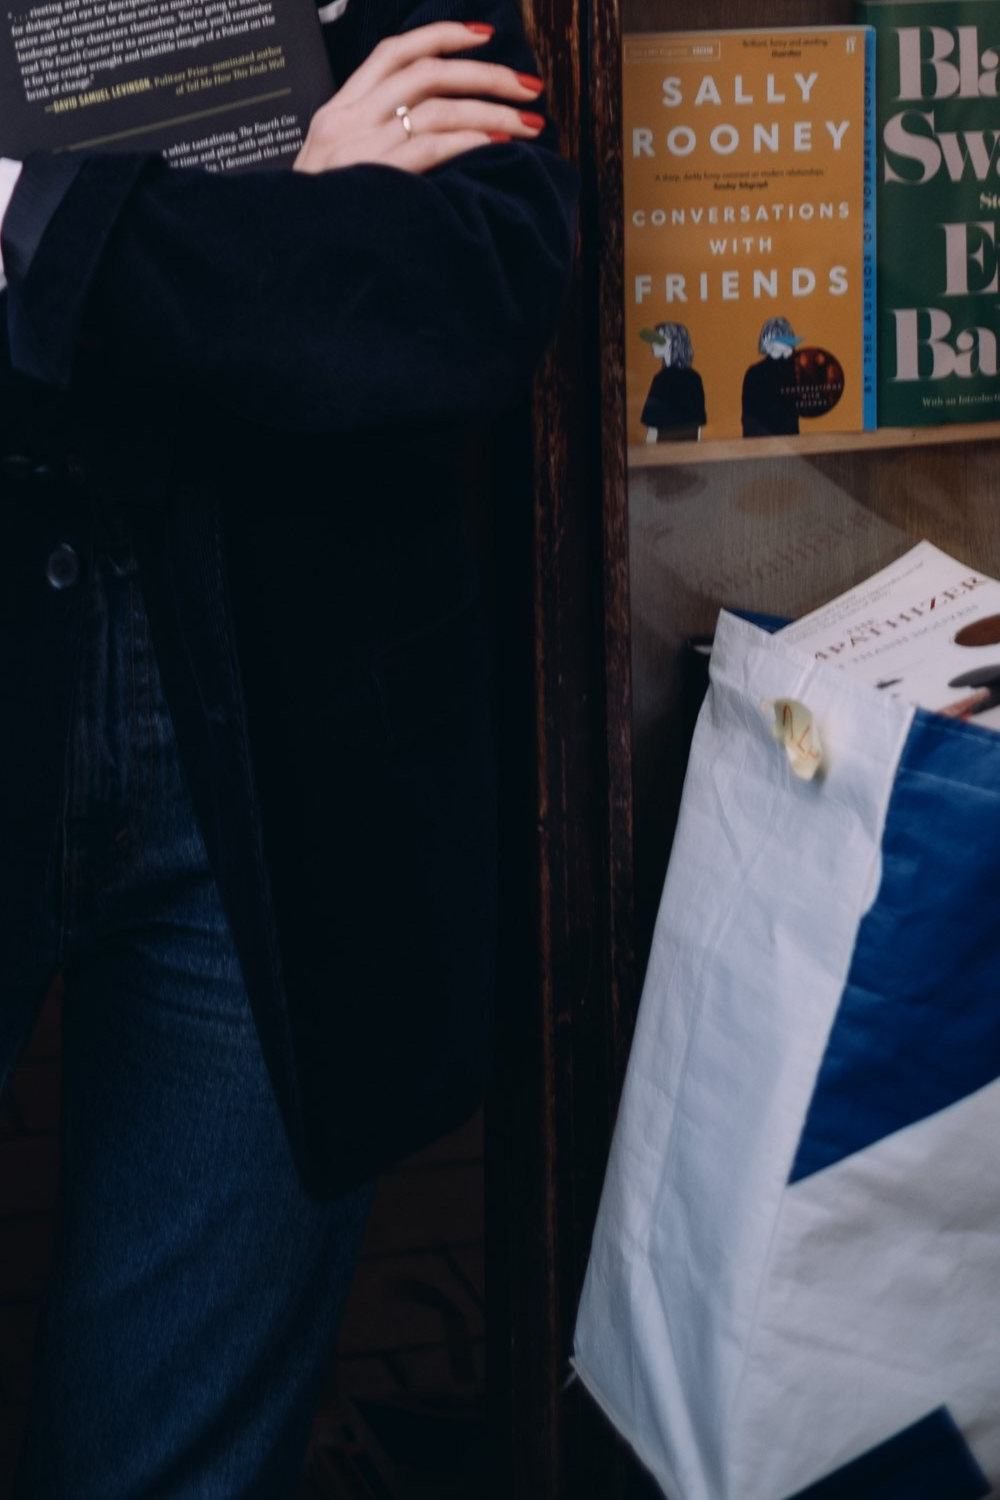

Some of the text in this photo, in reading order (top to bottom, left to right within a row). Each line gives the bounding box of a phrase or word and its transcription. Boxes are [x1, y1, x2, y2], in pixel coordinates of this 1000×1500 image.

[29, 1, 62, 18] riveting
[26, 85, 49, 101] brink
[50, 82, 59, 95] of
[78, 88, 109, 105] SAMUEL
[661, 72, 819, 108] SALLY
[632, 120, 851, 158] ROONEY
[883, 108, 1000, 186] Sw
[631, 201, 851, 228] CONVERSATIONS
[709, 236, 773, 256] WITH
[634, 265, 849, 304] FRIENDS
